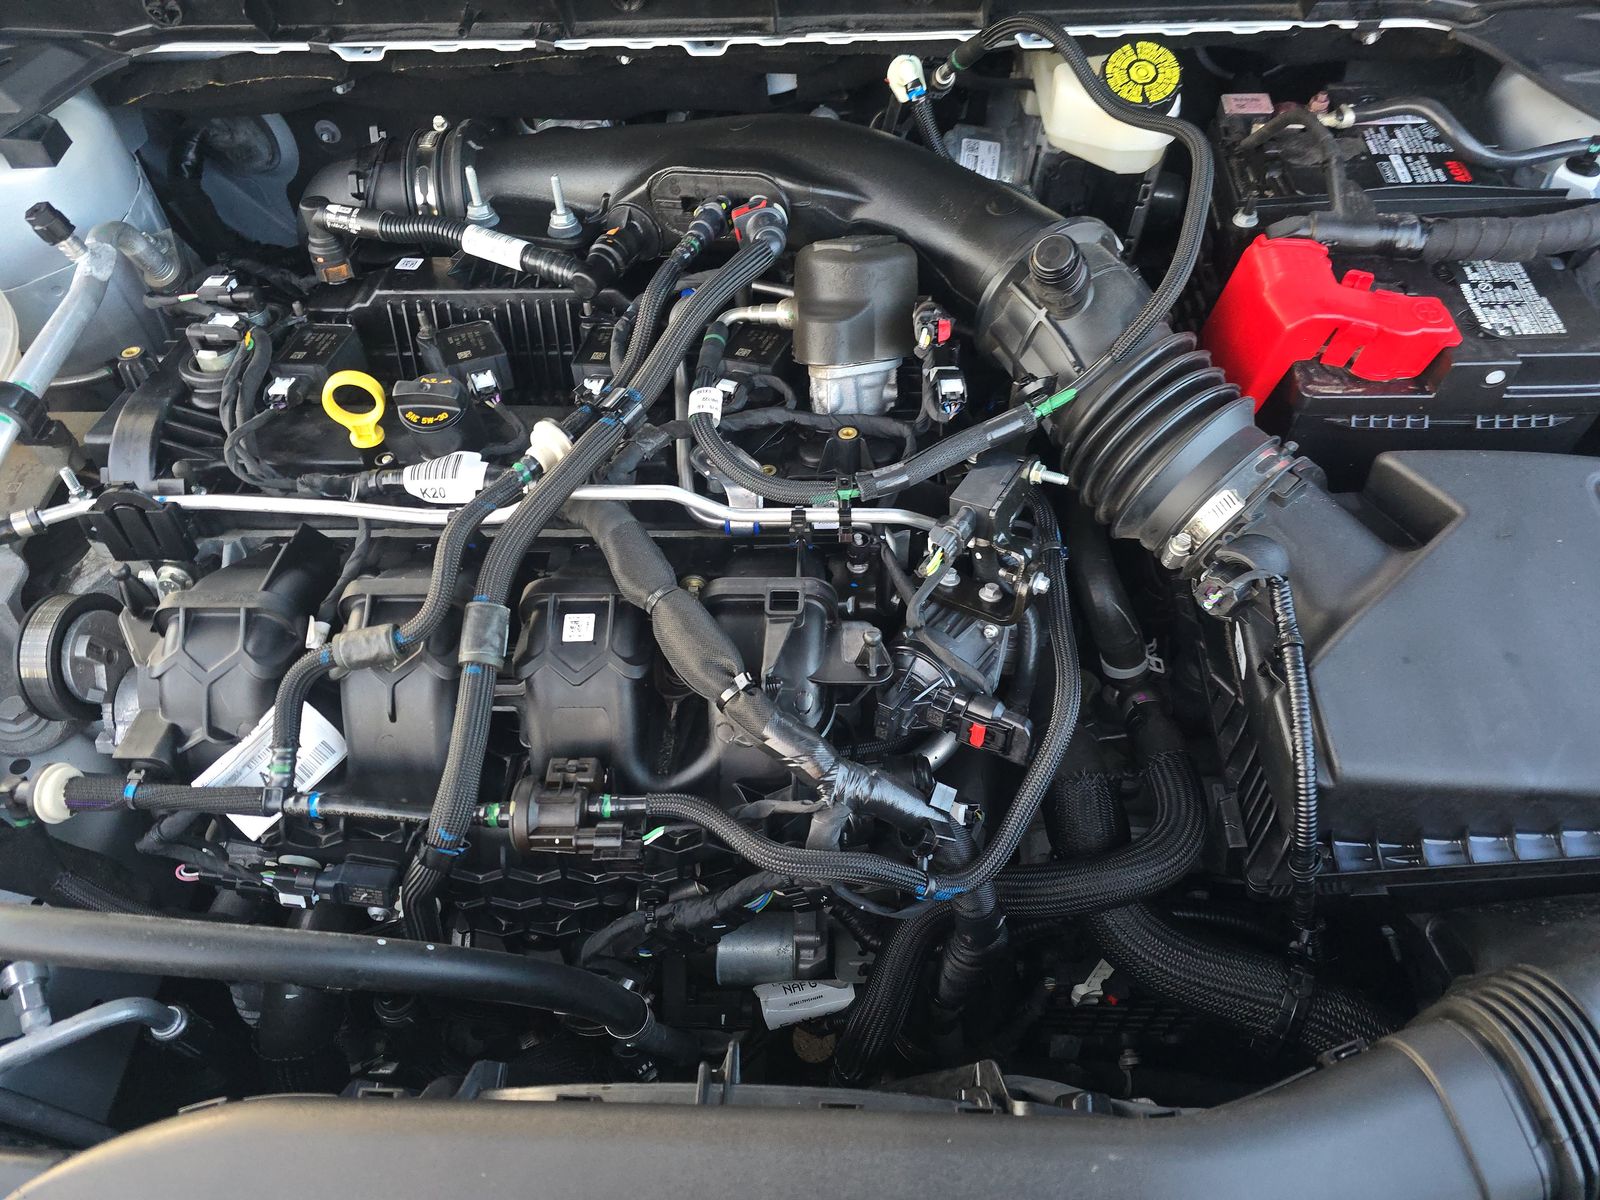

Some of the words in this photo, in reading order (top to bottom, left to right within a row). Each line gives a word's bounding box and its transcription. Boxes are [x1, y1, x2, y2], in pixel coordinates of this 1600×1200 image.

[405, 411, 420, 423] SAE
[421, 412, 449, 424] 5W-30
[420, 487, 446, 498] K20
